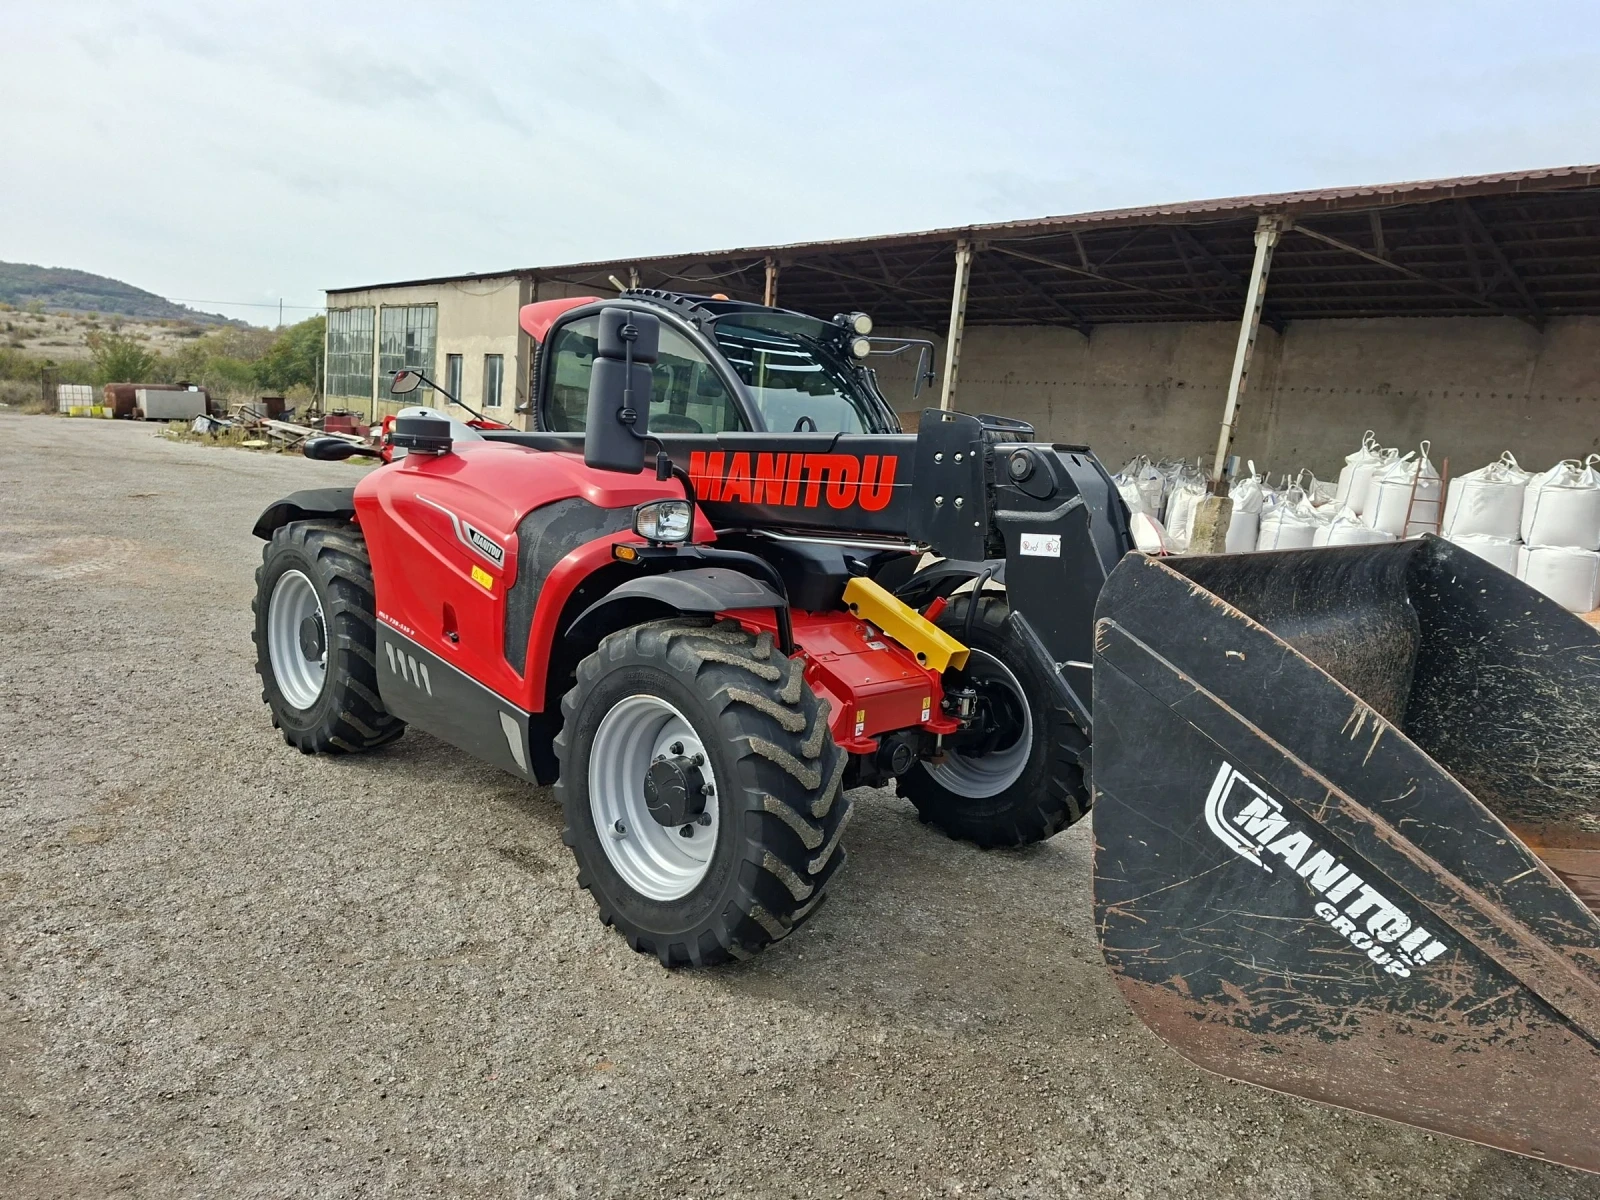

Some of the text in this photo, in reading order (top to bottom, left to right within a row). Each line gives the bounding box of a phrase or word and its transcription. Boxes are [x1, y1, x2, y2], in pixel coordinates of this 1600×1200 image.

[689, 451, 898, 511] MANITOU
[474, 532, 501, 559] MANITOU
[1233, 796, 1448, 967] MANITOU
[1314, 901, 1412, 978] GROUP
